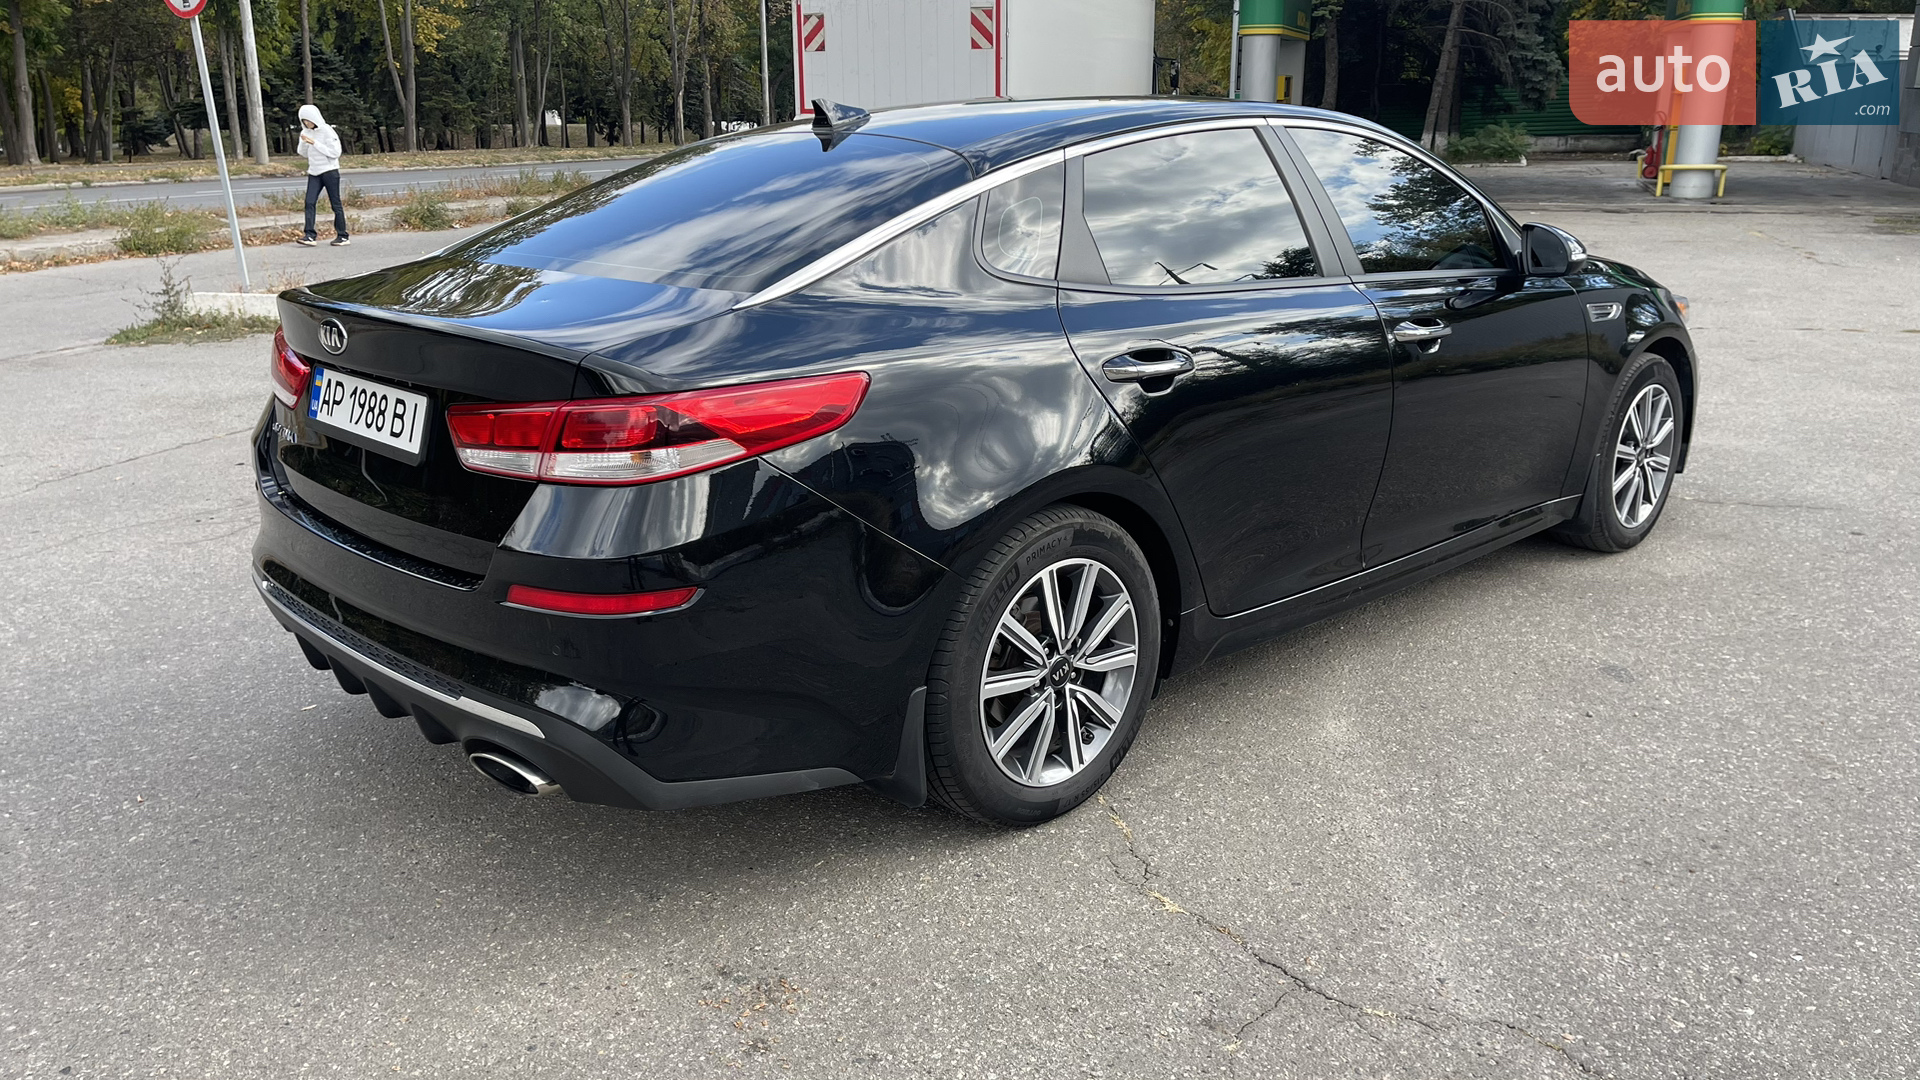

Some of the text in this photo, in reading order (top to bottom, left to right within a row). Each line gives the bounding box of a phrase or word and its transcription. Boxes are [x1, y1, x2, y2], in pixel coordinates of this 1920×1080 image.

[320, 324, 342, 348] KIA
[319, 378, 418, 443] AP 1988 BI
[1025, 536, 1063, 566] PRIMACY
[1052, 662, 1070, 681] KIA
